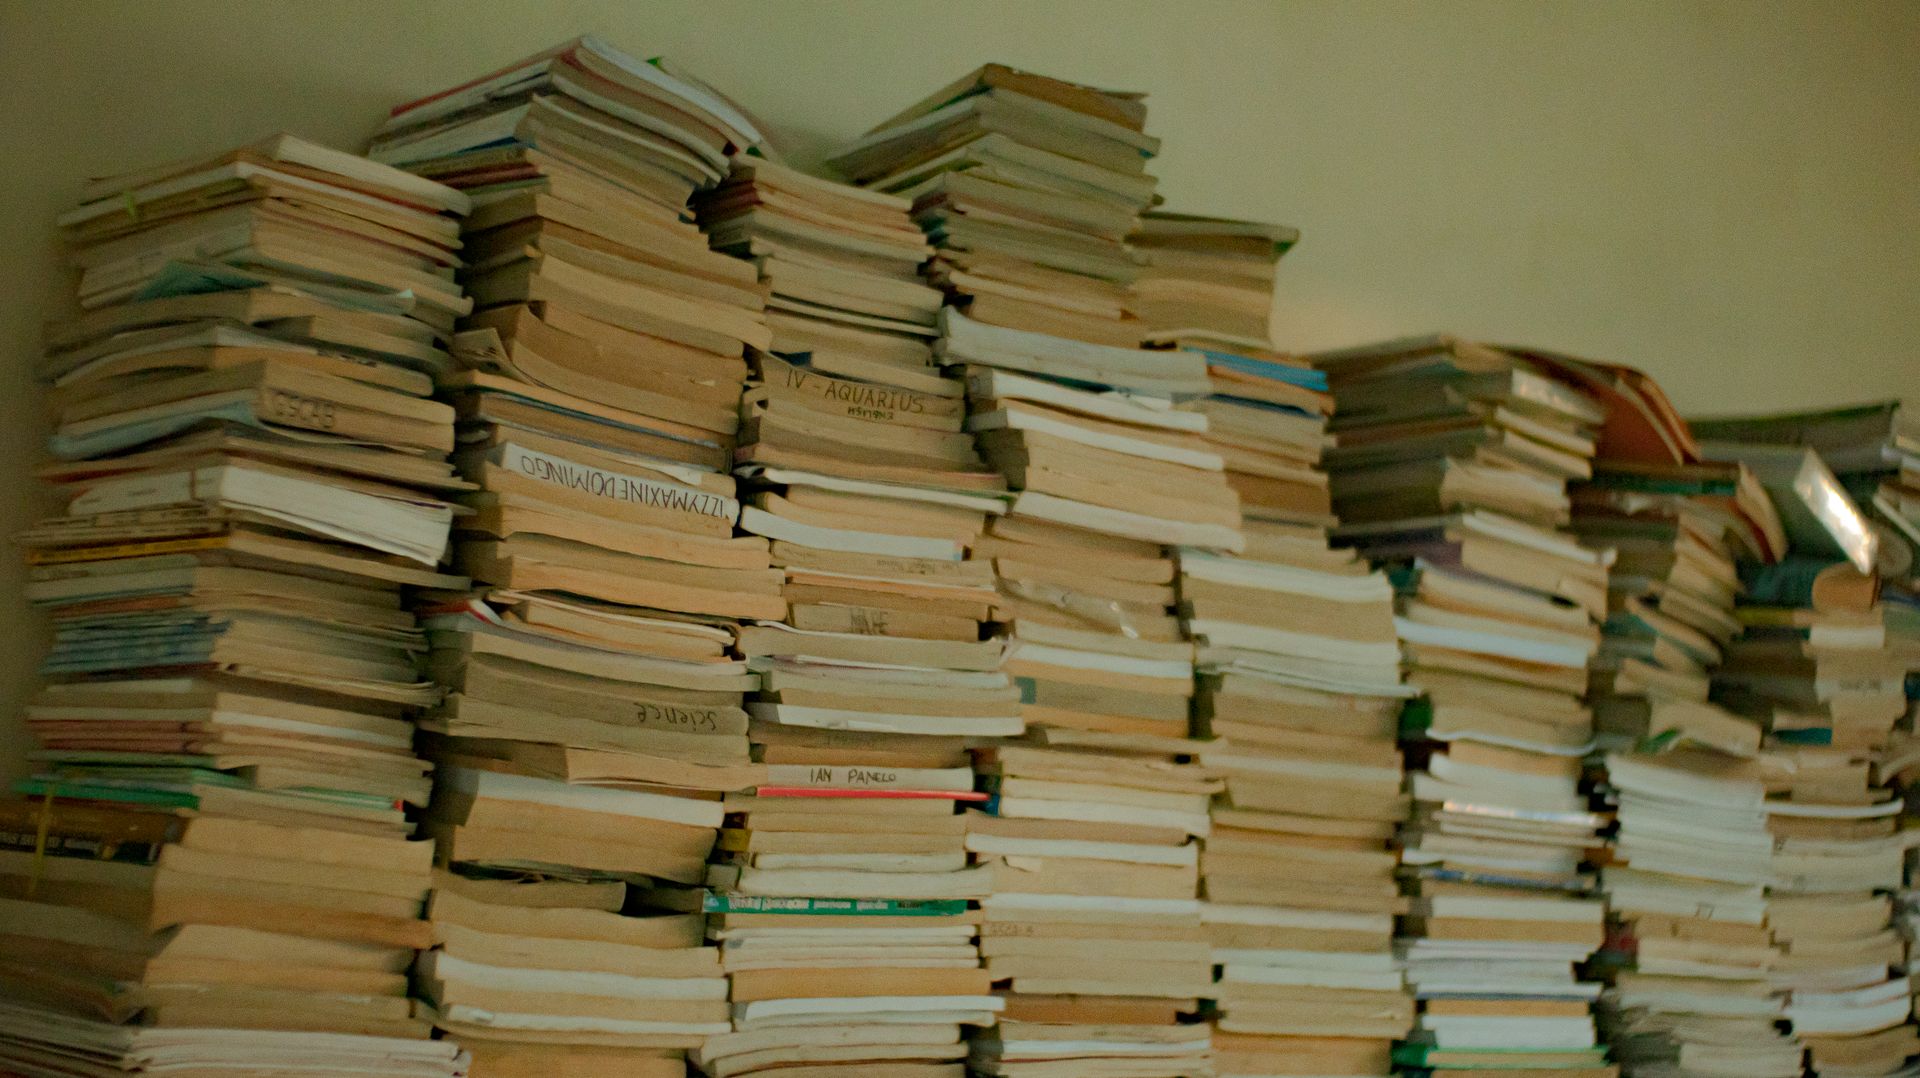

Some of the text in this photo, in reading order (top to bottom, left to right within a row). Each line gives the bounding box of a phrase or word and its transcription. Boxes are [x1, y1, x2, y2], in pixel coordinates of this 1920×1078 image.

[786, 369, 807, 389] IV
[824, 381, 925, 414] AQUARIUS
[847, 406, 894, 421] ENGLISH
[810, 767, 832, 783] IAN
